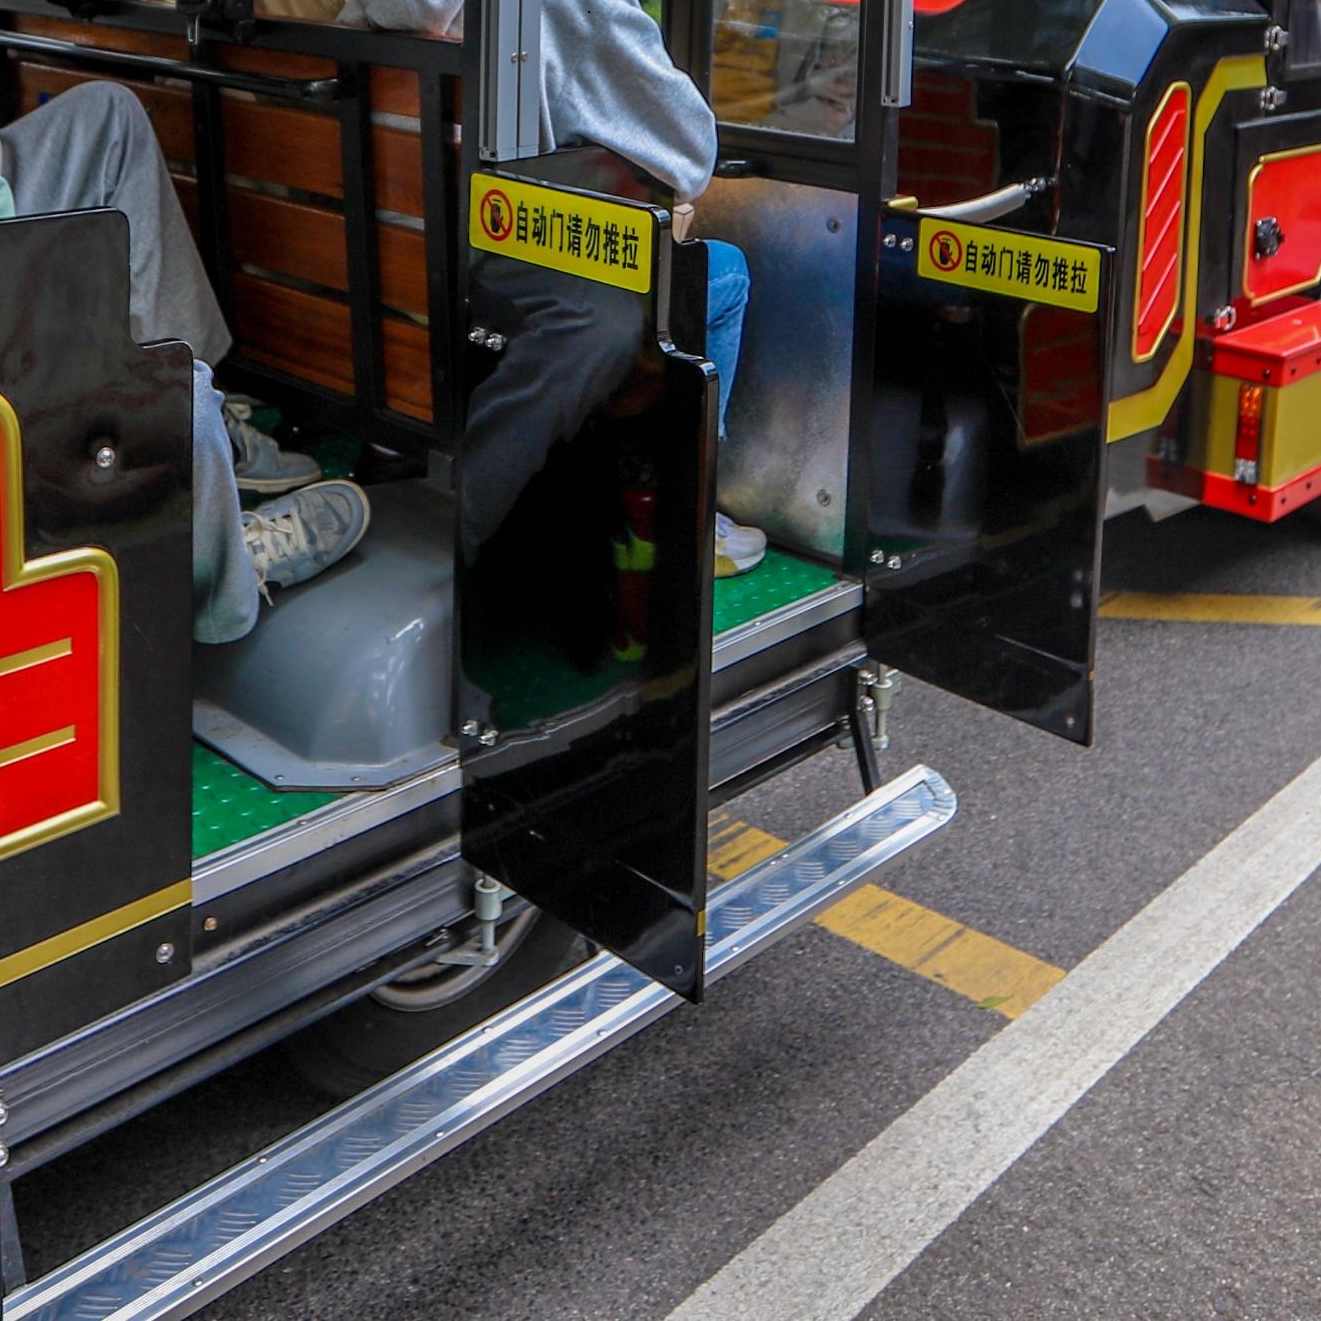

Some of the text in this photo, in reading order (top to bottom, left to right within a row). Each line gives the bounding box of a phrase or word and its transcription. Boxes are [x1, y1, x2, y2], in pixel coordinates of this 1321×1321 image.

[516, 200, 639, 271] 自动门请勿推拉
[965, 240, 1088, 294] 自动门请勿推拉
